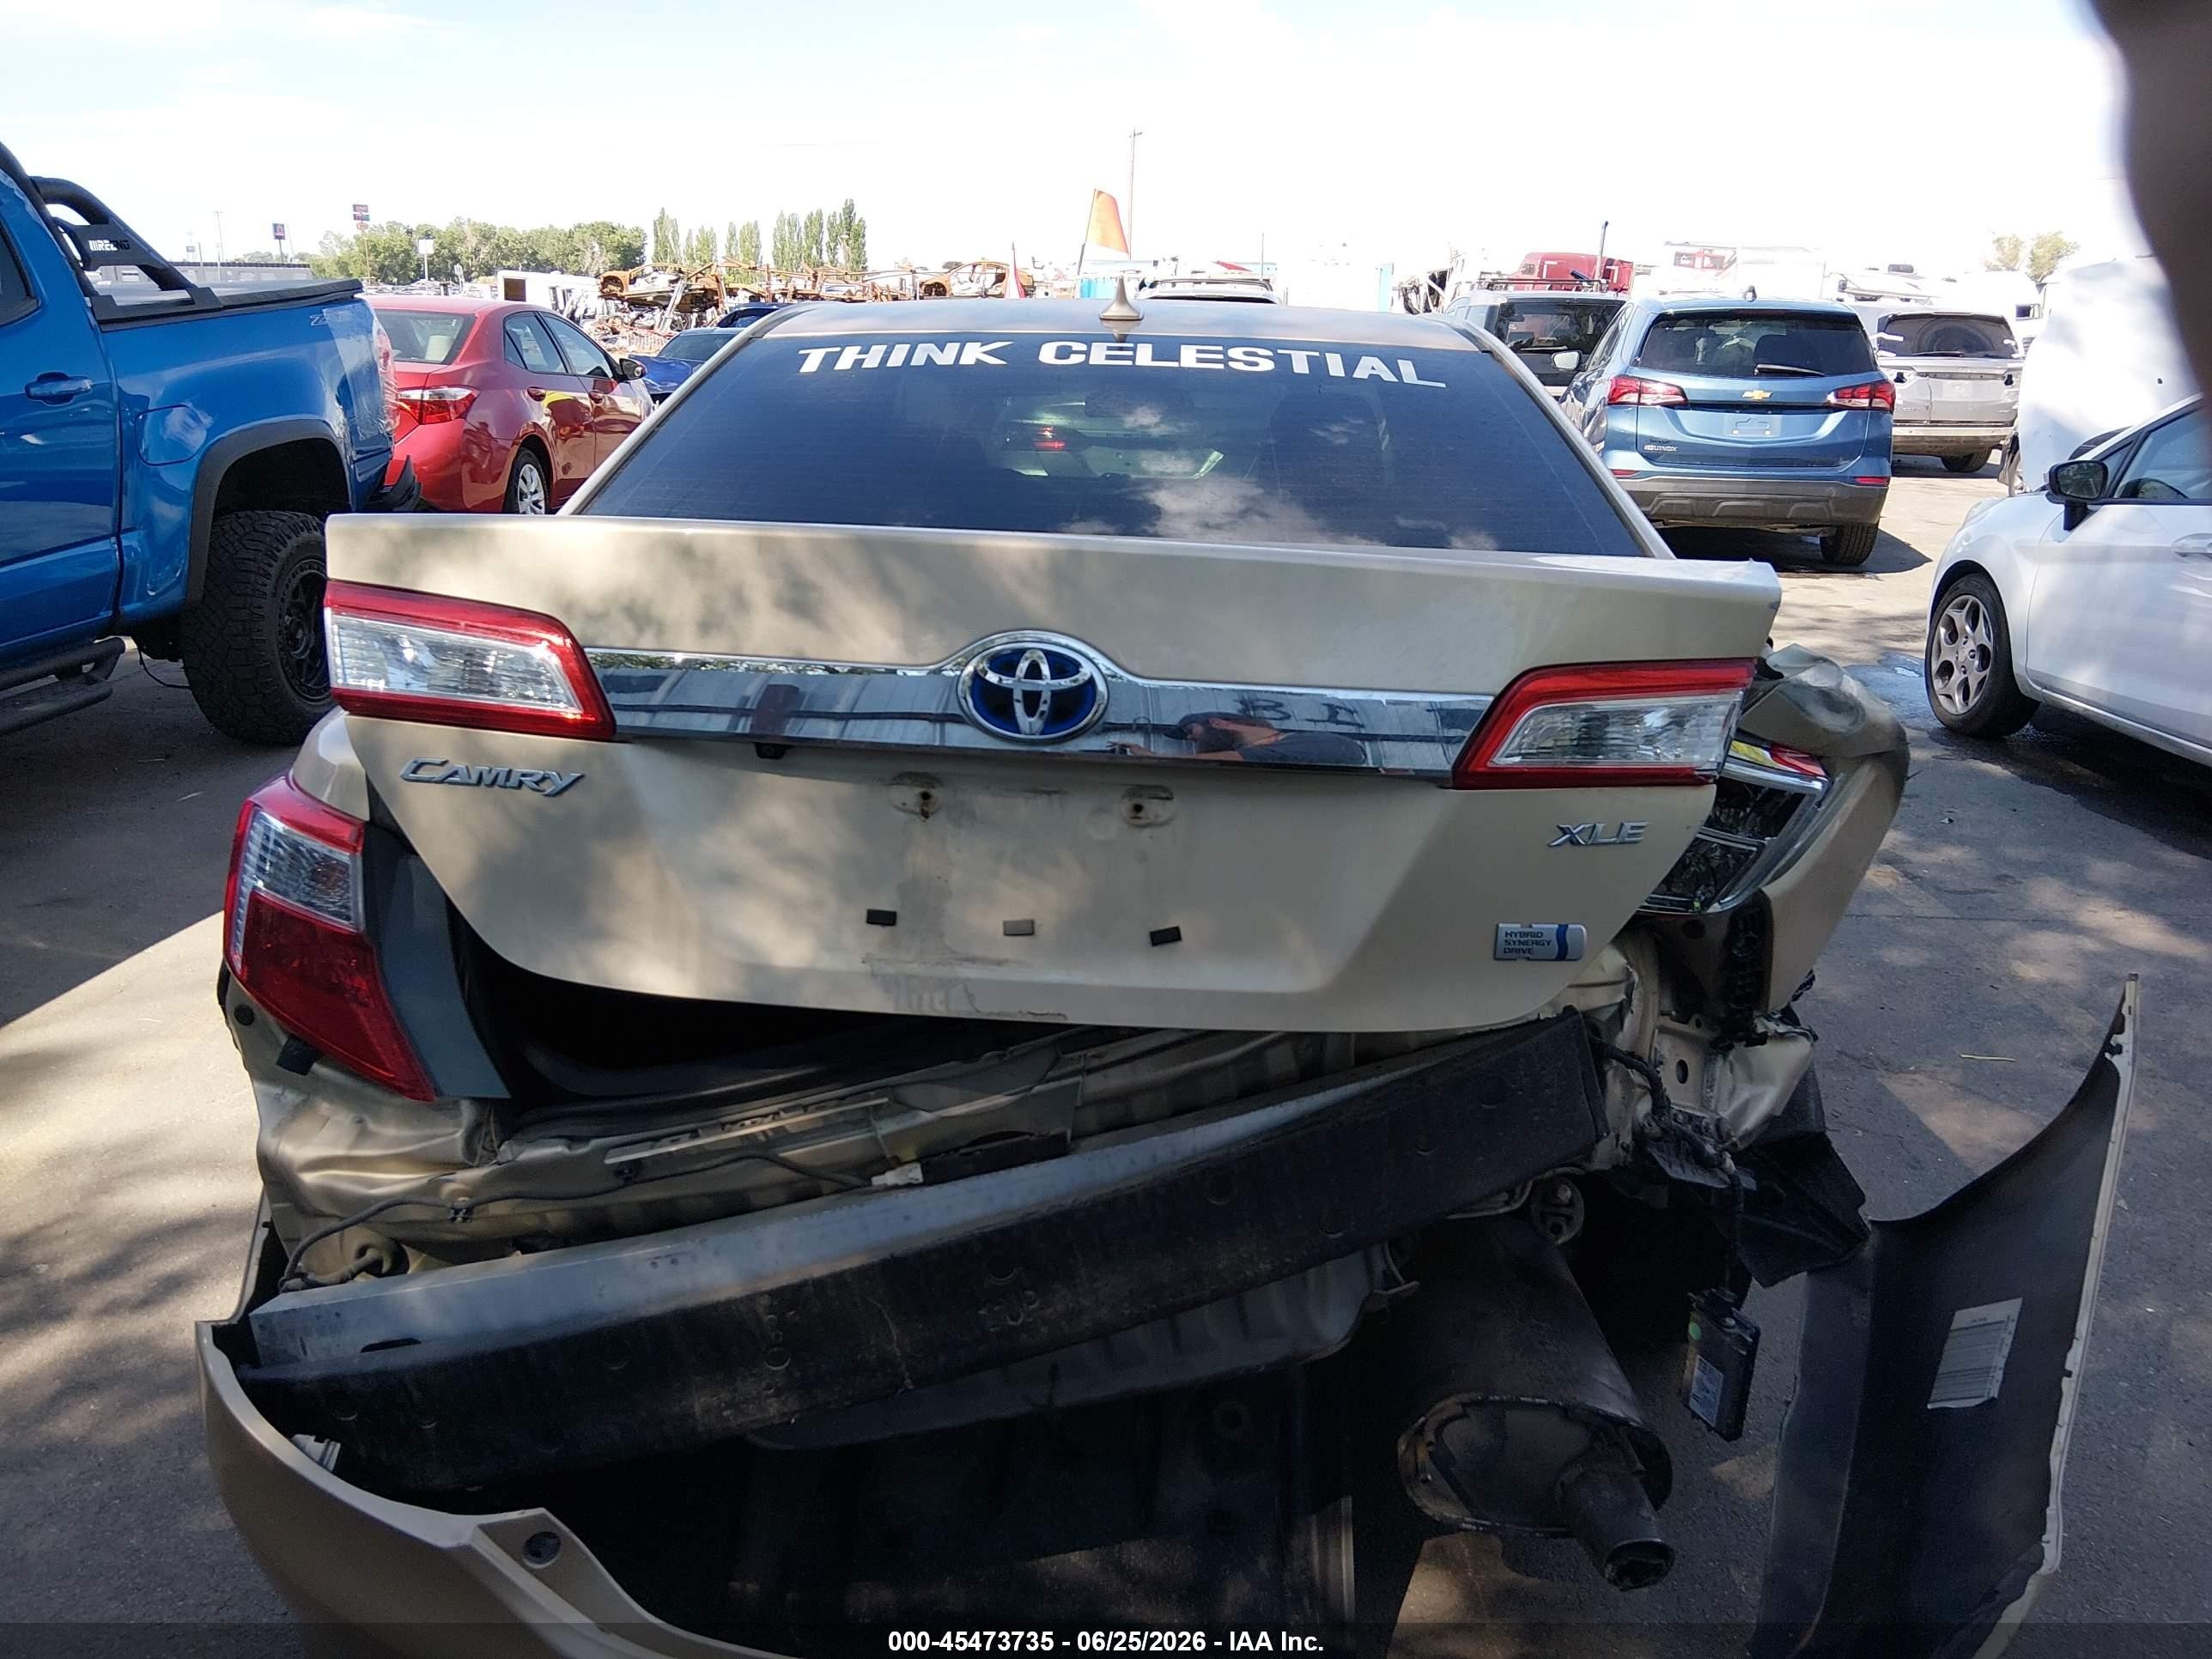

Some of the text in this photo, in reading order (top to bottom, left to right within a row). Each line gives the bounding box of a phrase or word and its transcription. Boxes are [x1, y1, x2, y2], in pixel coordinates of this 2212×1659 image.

[798, 341, 1447, 388] THINK CELESTIAL
[399, 757, 586, 797] CAMRY
[1547, 821, 1649, 848] XLE
